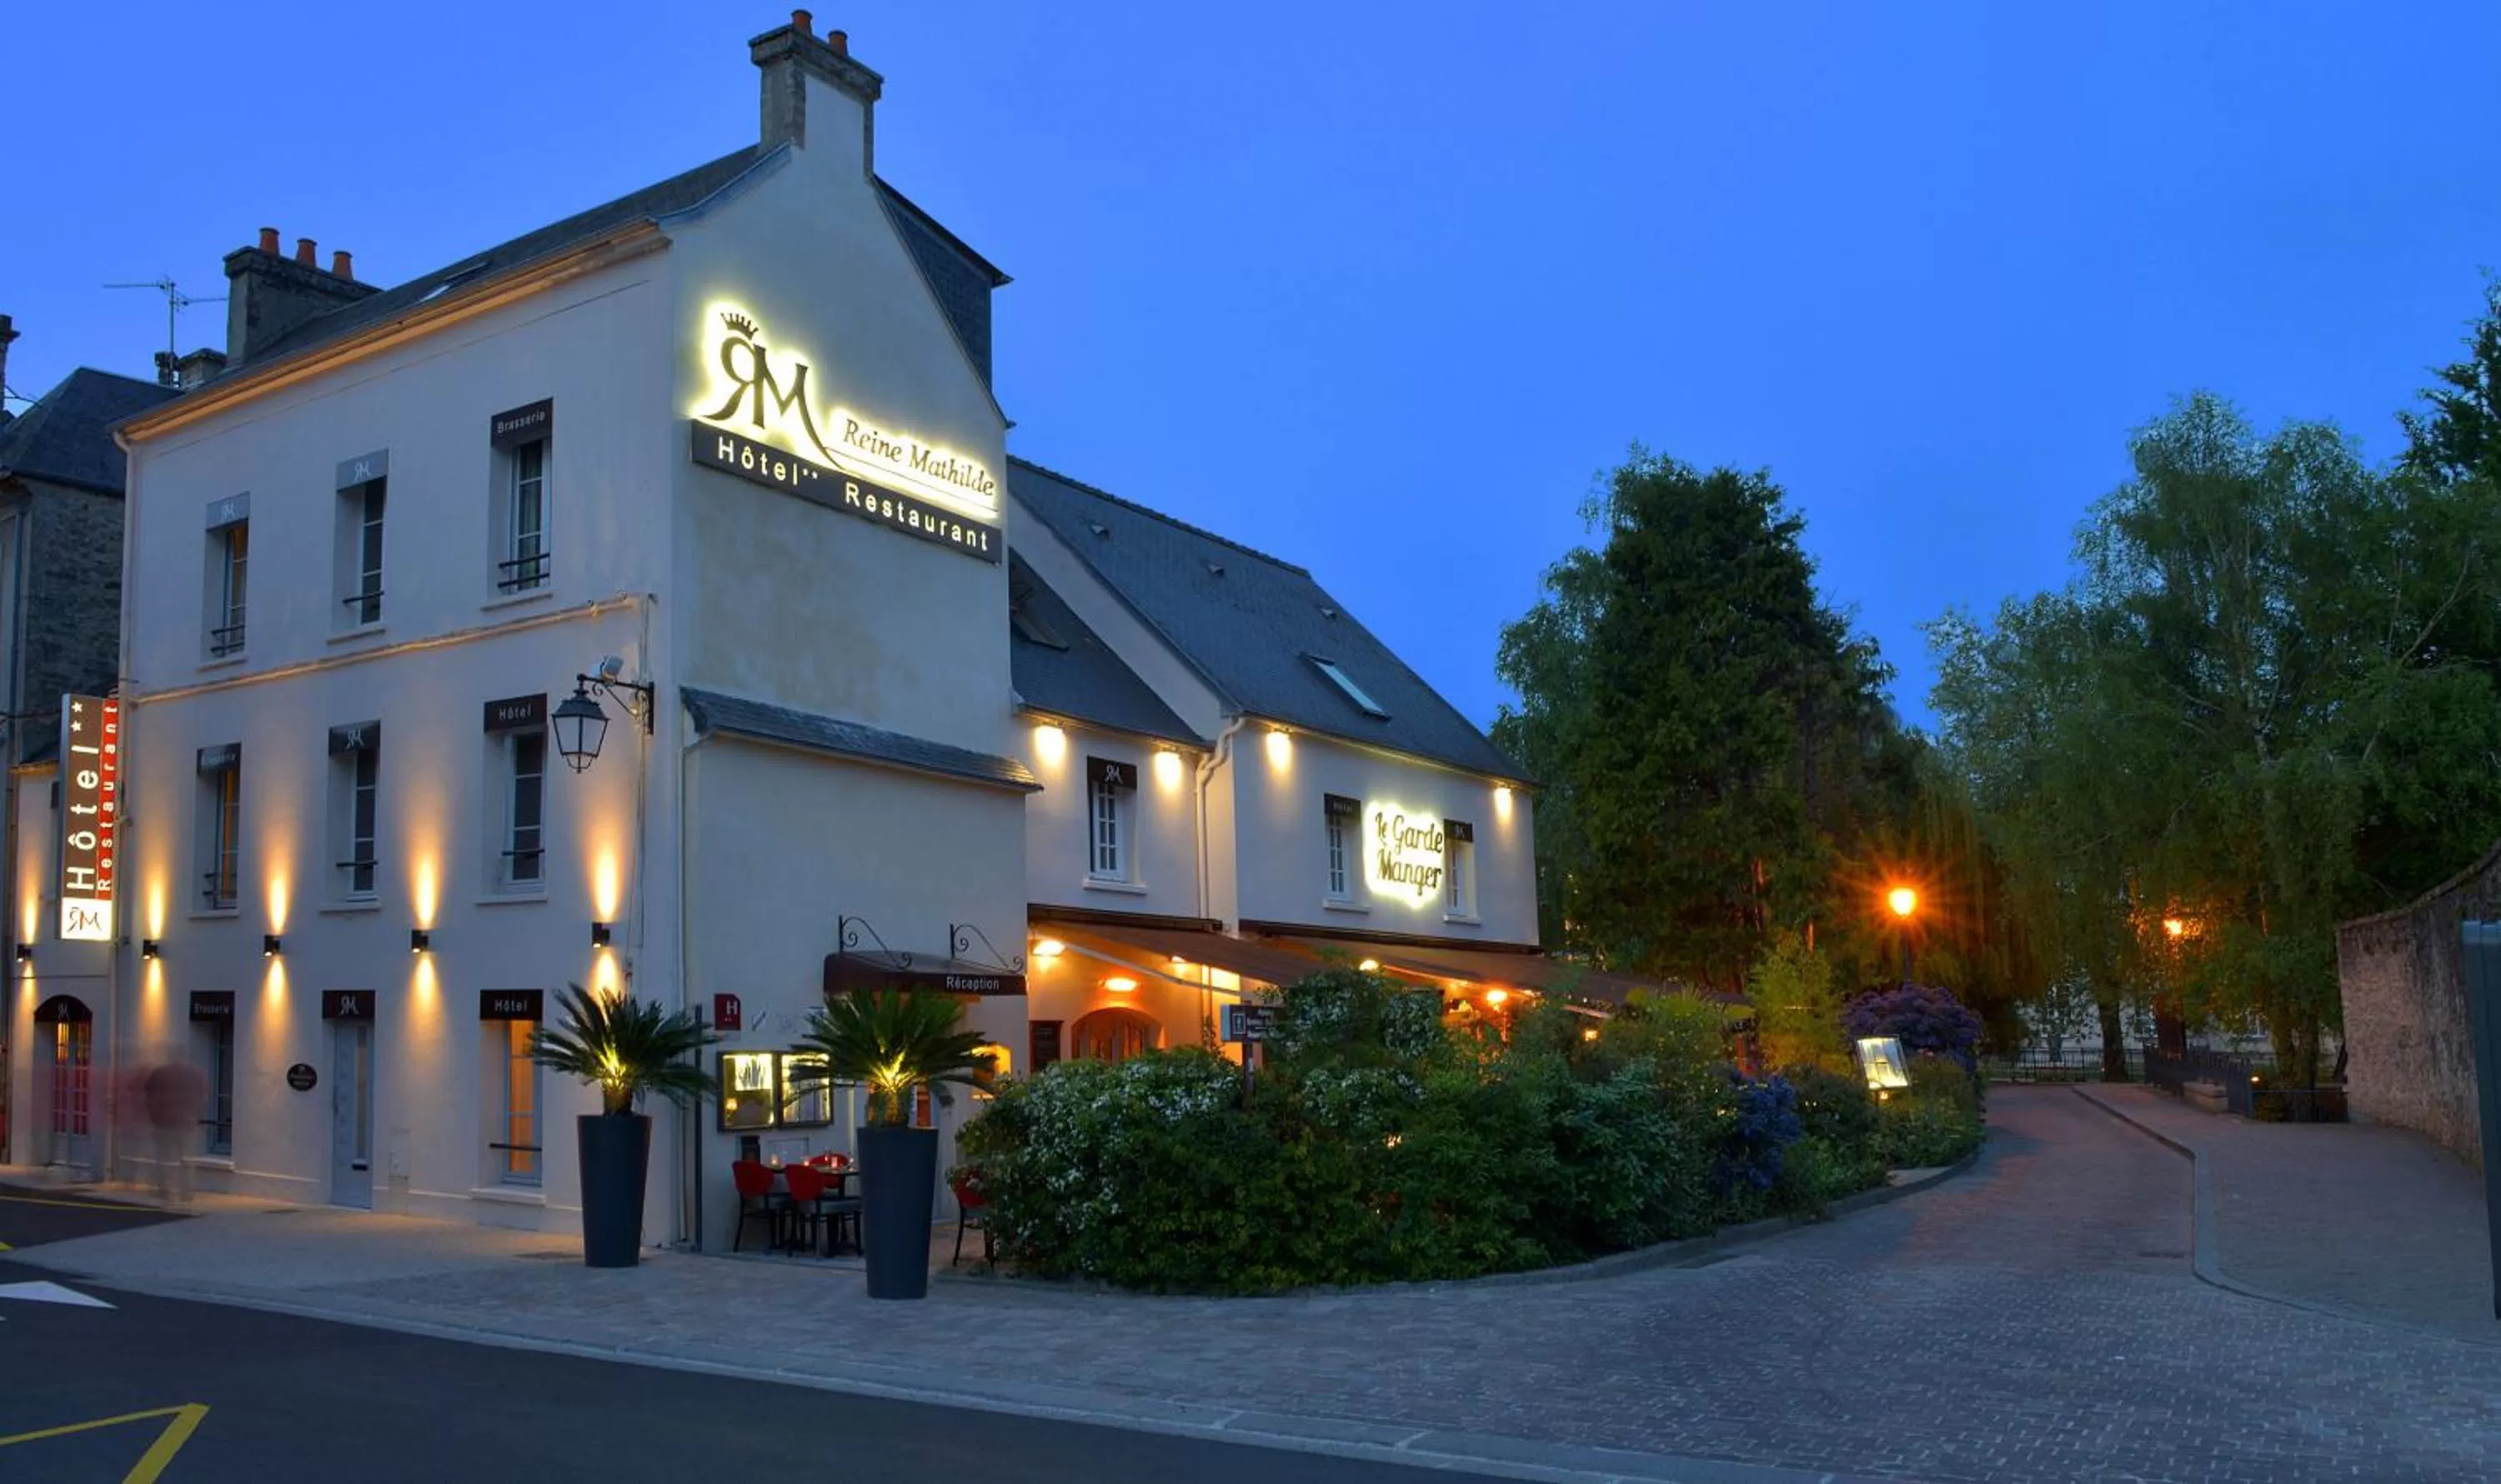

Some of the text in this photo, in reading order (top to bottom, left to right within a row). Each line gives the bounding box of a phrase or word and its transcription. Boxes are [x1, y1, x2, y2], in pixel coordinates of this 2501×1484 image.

[843, 419, 994, 496] Reine Mathilde
[845, 481, 987, 550] Restaurant
[67, 745, 99, 890] Hôtel
[98, 705, 118, 891] Restaurant
[1393, 815, 1442, 855] Garde
[1377, 849, 1442, 896] Manger
[726, 1000, 738, 1015] H
[946, 975, 1000, 990] Réception
